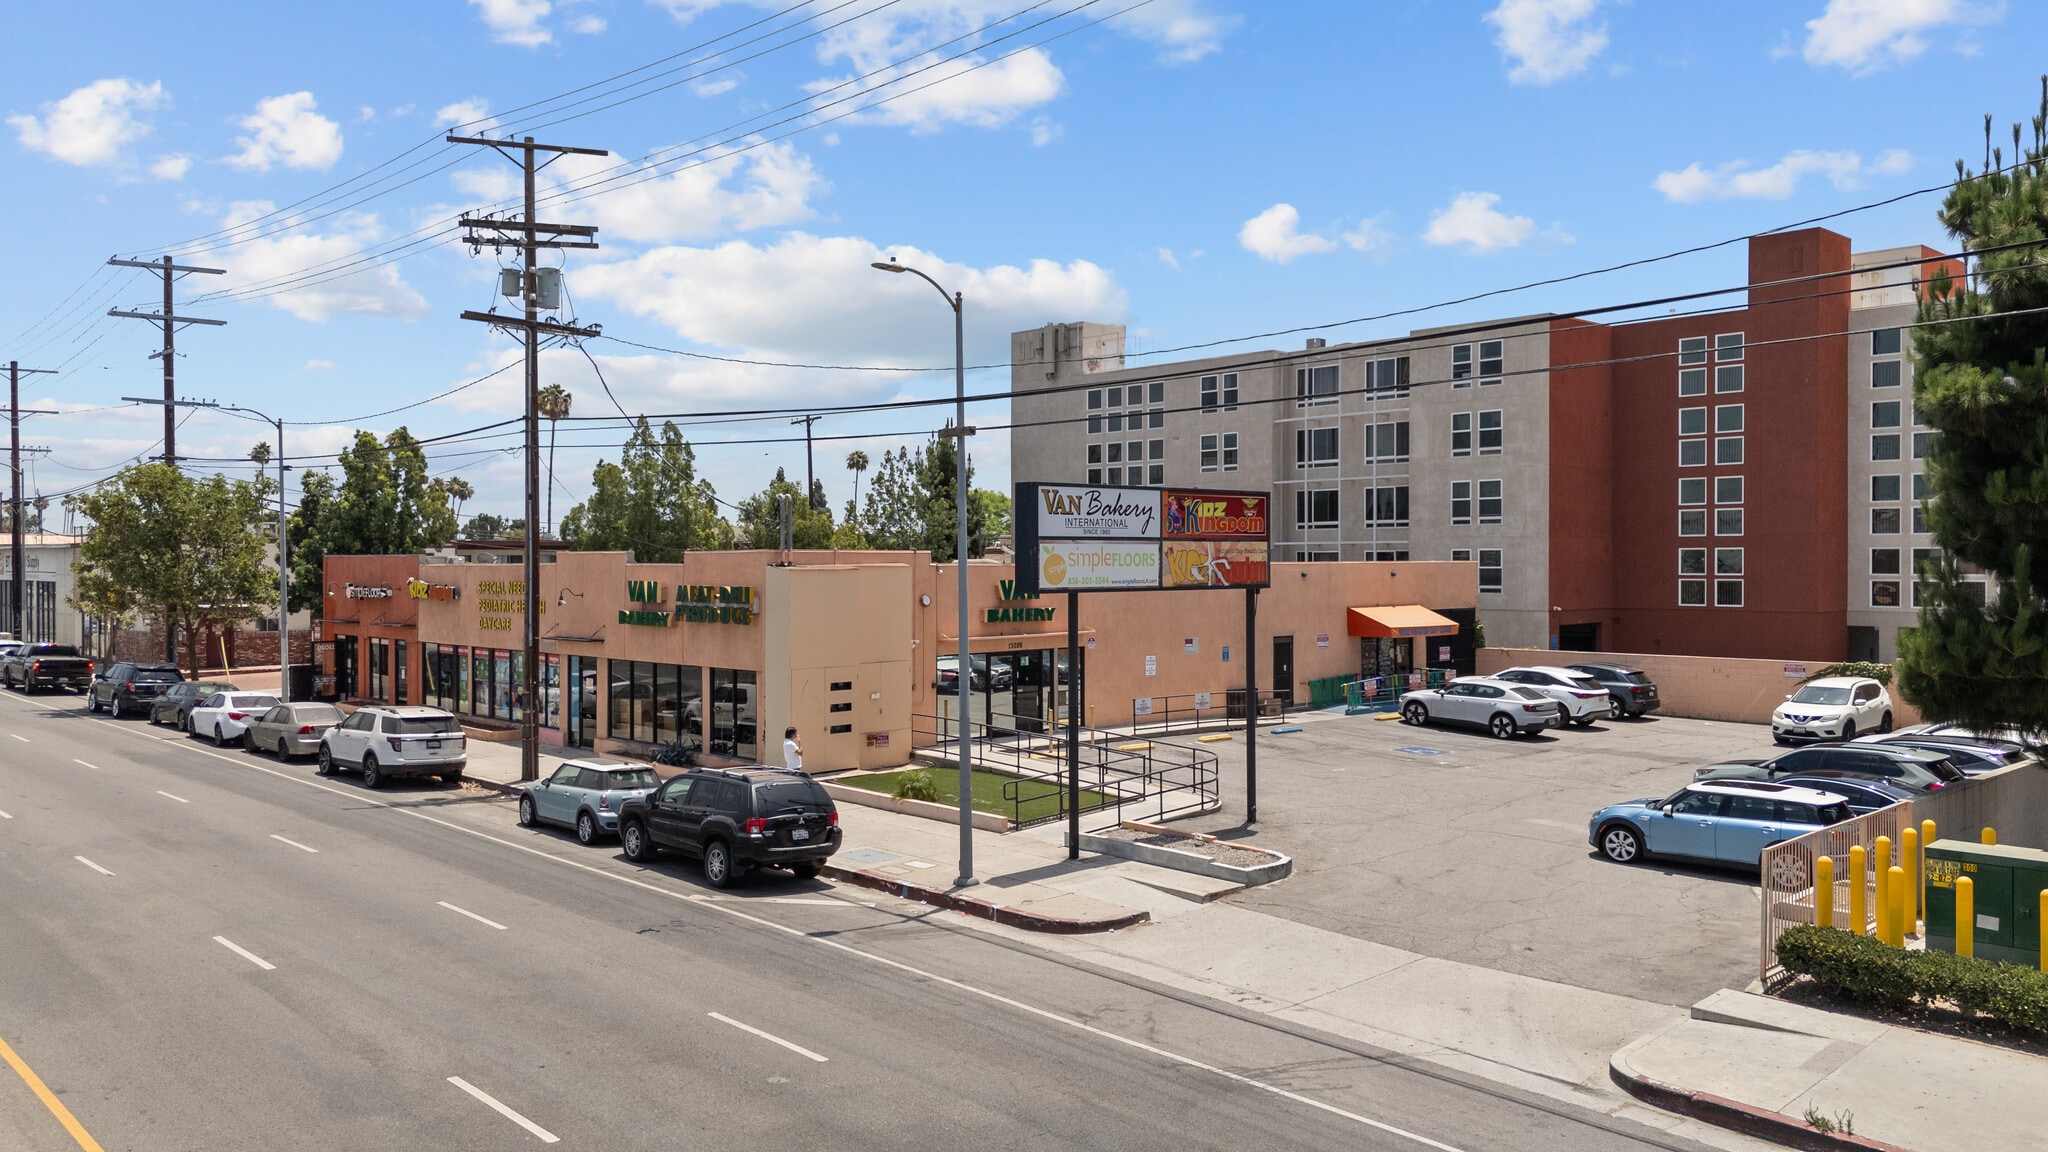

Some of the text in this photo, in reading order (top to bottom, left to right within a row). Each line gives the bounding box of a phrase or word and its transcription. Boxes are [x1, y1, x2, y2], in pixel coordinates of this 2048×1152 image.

[1041, 489, 1155, 535] VAN Bakery
[1065, 518, 1128, 528] INTERNATIONAL
[1068, 546, 1155, 573] simpleFLOORS
[479, 581, 525, 594] SPECIAL NEED
[627, 580, 660, 603] VAN
[479, 600, 514, 613] PEDIATRIC
[675, 605, 755, 625] PRODUCE
[985, 607, 1056, 623] BAKERY
[479, 618, 511, 631] DAYCARE
[1963, 863, 1977, 872] 300
